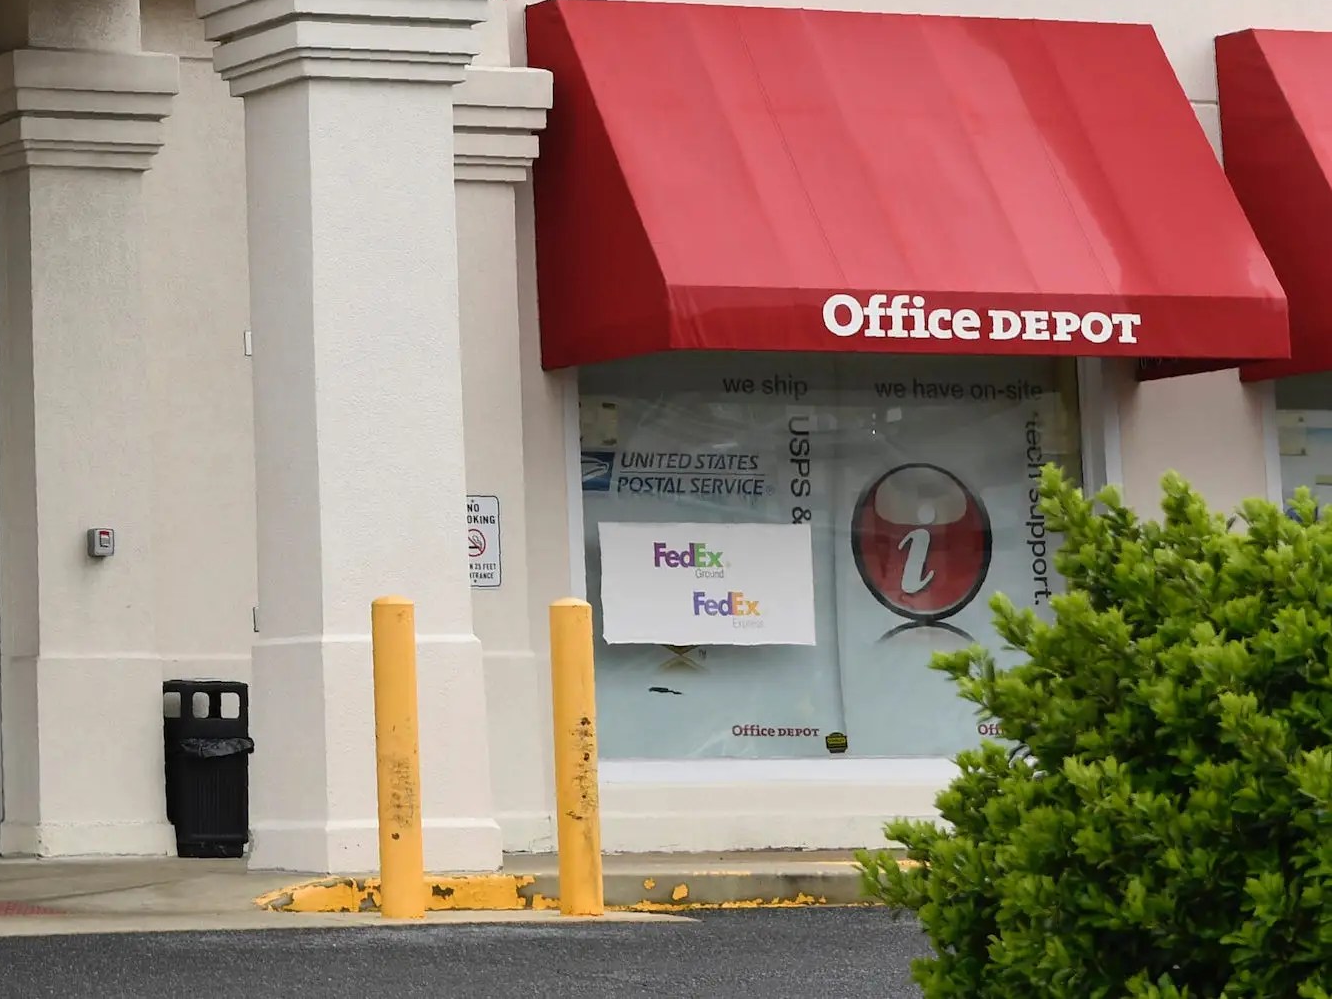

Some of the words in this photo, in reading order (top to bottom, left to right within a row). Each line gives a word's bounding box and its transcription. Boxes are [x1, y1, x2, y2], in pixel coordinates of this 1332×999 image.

[823, 293, 981, 340] Office
[988, 309, 1141, 344] DEPOT
[723, 377, 755, 394] we
[761, 373, 808, 400] ship
[874, 382, 906, 399] we
[912, 379, 964, 399] have
[970, 379, 1043, 400] on-site
[620, 451, 692, 469] UNITED
[694, 454, 759, 470] STATES
[789, 415, 811, 497] USPS
[618, 476, 686, 493] POSTAL
[690, 477, 764, 496] SERVICE
[467, 503, 480, 512] NO
[467, 515, 496, 524] OKING
[654, 542, 723, 567] FedEx
[695, 569, 724, 578] Ground
[693, 591, 760, 616] FedEx
[732, 725, 775, 737] Office
[778, 728, 819, 737] DEPOT
